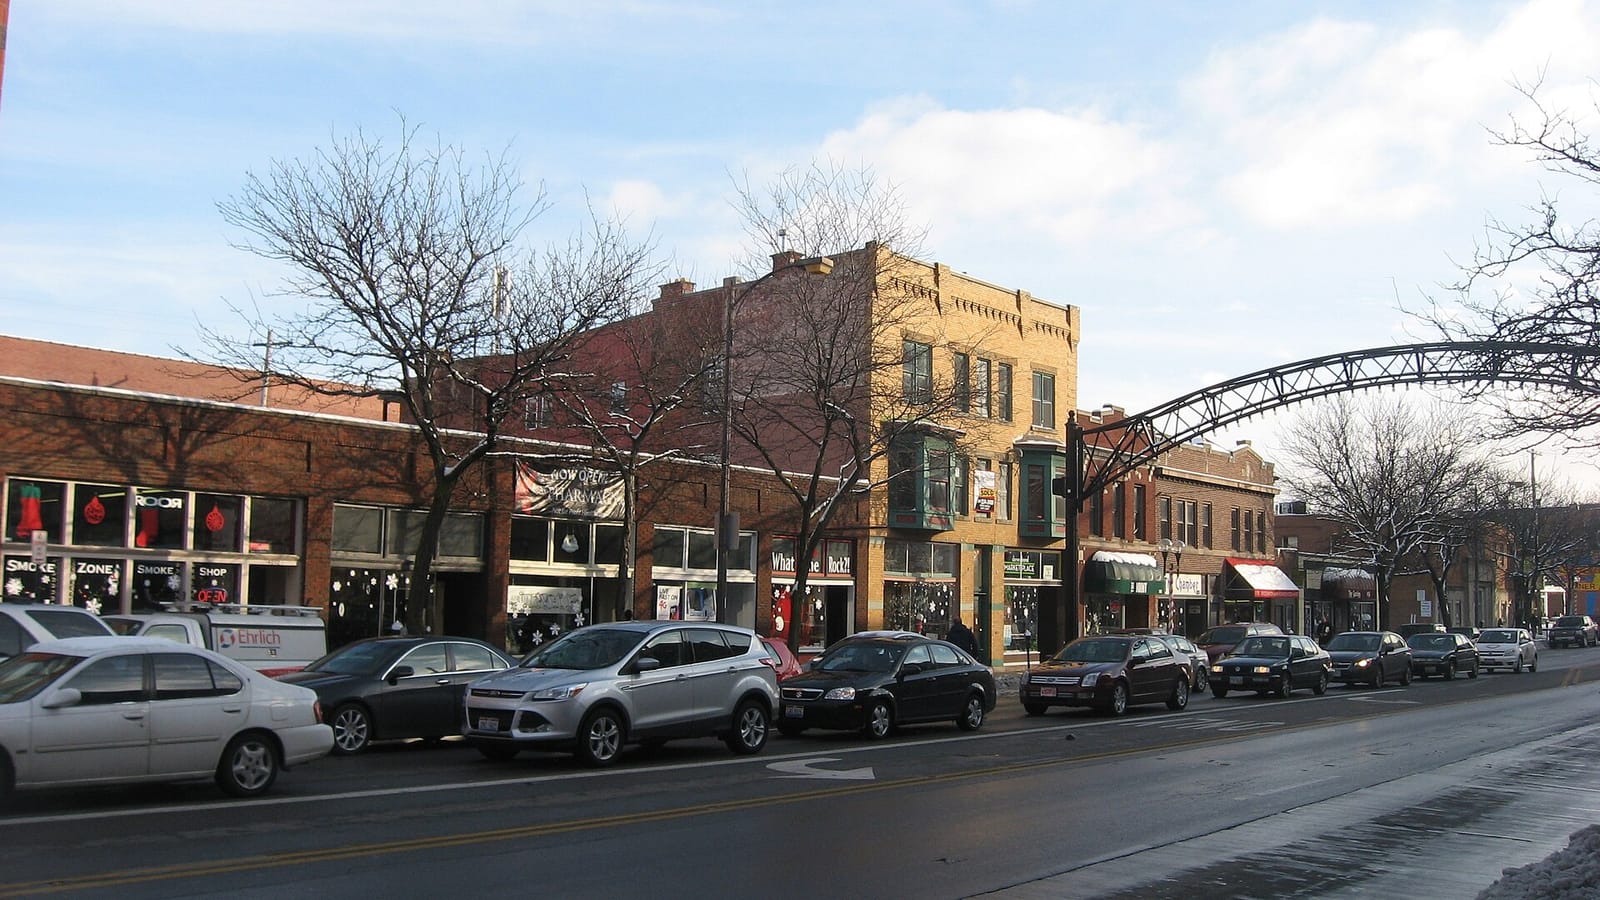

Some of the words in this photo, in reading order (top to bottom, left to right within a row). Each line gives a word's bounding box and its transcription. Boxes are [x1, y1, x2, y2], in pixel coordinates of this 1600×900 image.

[550, 469, 578, 481] NOW
[77, 562, 113, 574] ZONE
[137, 564, 174, 575] SMOKE
[199, 567, 227, 577] SHOP
[771, 551, 795, 571] What
[828, 555, 850, 573] Rock?!
[659, 599, 667, 609] 4G
[238, 628, 281, 645] Ehrlich
